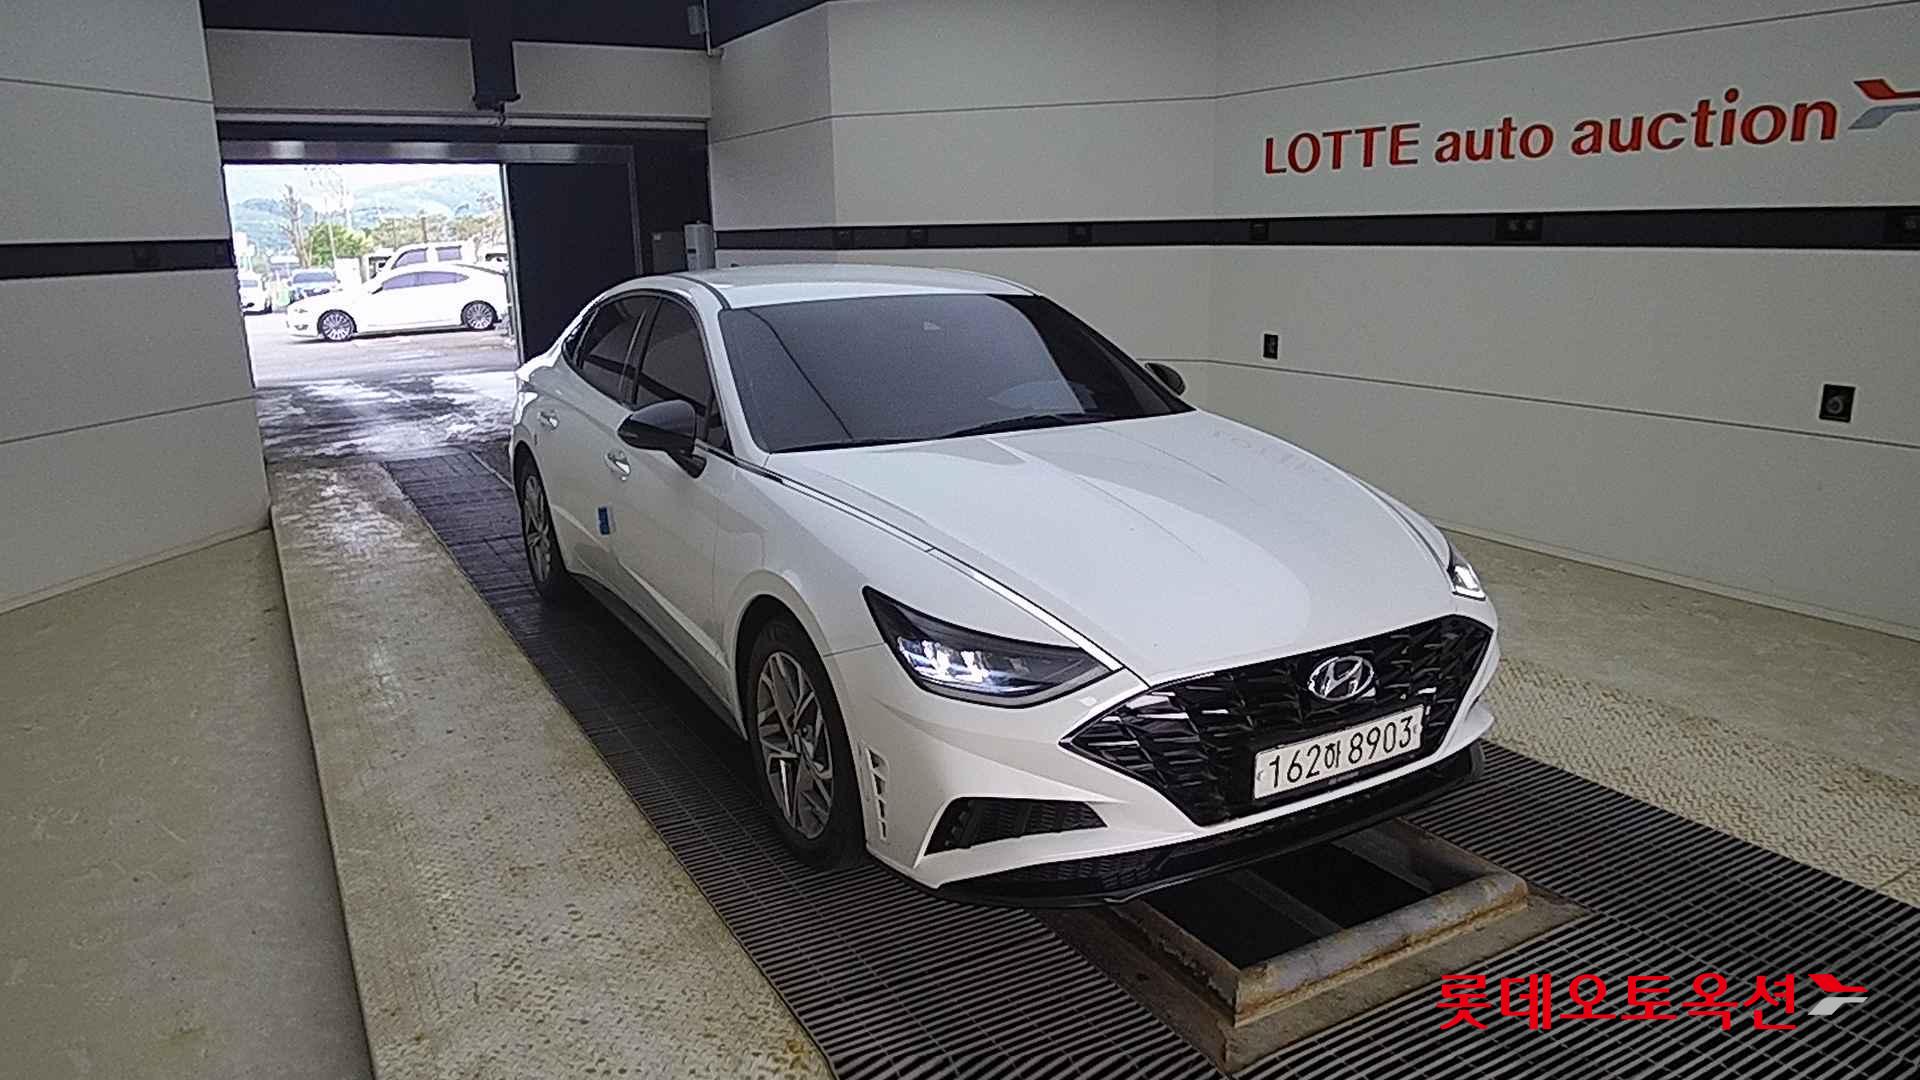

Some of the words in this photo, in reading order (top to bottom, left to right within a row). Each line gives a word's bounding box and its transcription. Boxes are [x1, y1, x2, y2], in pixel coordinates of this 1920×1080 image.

[1265, 123, 1421, 175] LOTTE
[1435, 116, 1554, 165] auto
[1570, 87, 1839, 156] auction
[1348, 715, 1414, 765] 8903
